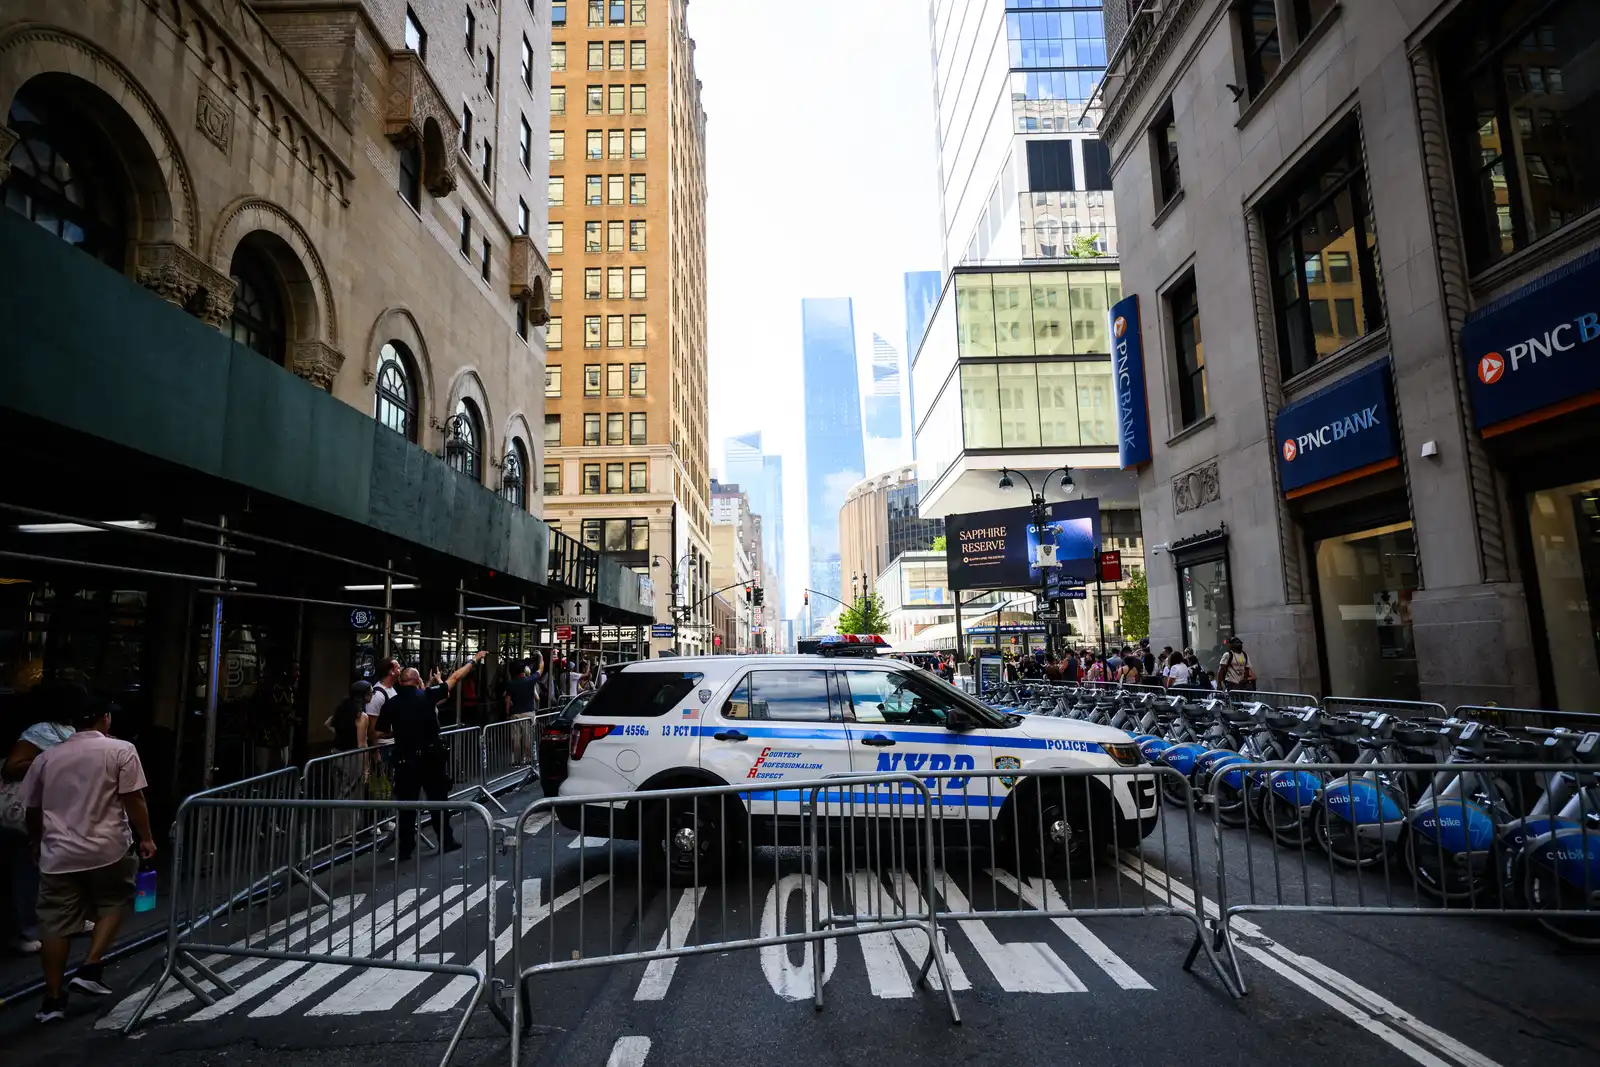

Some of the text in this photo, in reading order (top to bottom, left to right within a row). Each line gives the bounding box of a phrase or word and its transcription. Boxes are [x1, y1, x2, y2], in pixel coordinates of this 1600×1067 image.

[1506, 323, 1576, 371] PNC
[1116, 339, 1136, 451] PNC BANK
[1296, 403, 1381, 455] PNC BANK
[959, 526, 1007, 541] SAPPHIRE
[961, 540, 1006, 554] RESERVE
[624, 725, 646, 736] 4556
[662, 725, 690, 737] 13 PCT
[760, 746, 802, 759] COURTESY
[1047, 739, 1088, 752] POLICE
[754, 757, 824, 770] PROFESSIONALISM
[868, 752, 975, 789] NYPD
[747, 767, 784, 779] RESPECT
[760, 867, 1157, 1001] ONLY
